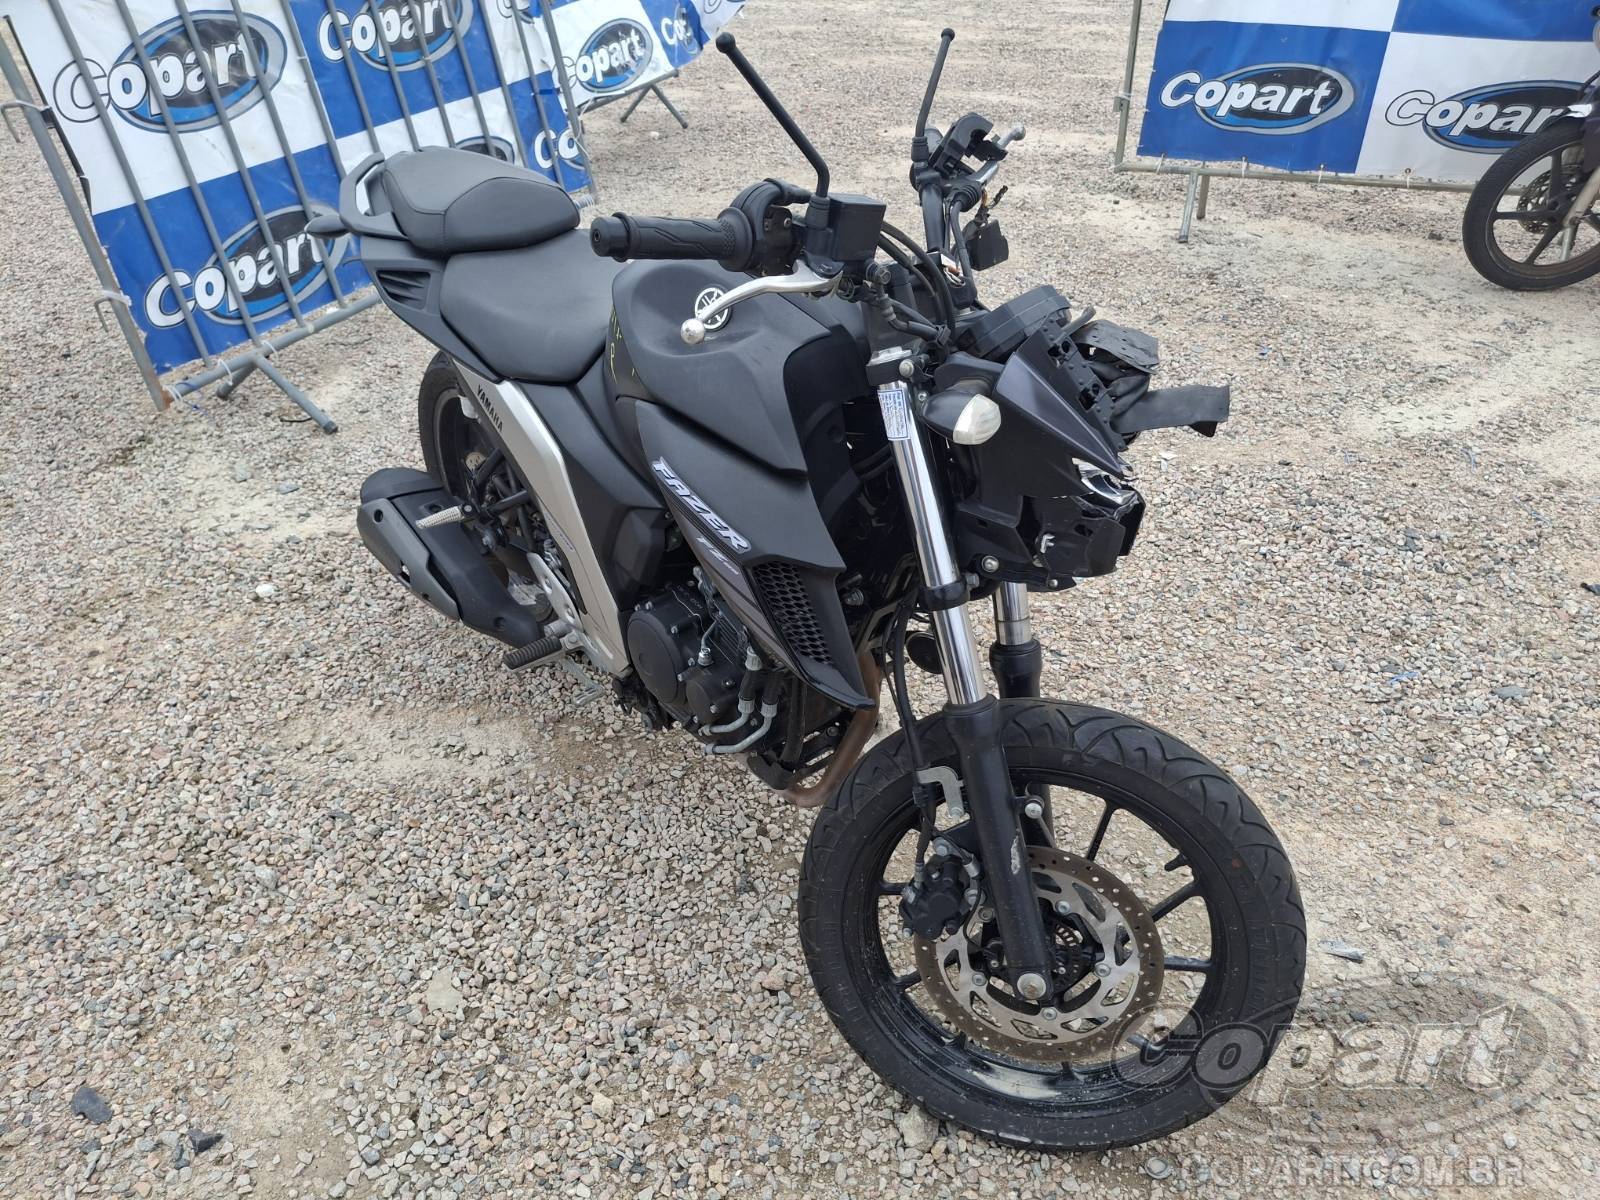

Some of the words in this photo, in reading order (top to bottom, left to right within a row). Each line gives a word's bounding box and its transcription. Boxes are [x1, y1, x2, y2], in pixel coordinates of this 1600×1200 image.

[1161, 72, 1331, 117] Copart
[1384, 89, 1566, 137] Copar
[476, 384, 503, 432] YAMAHA
[652, 461, 750, 551] FAZER
